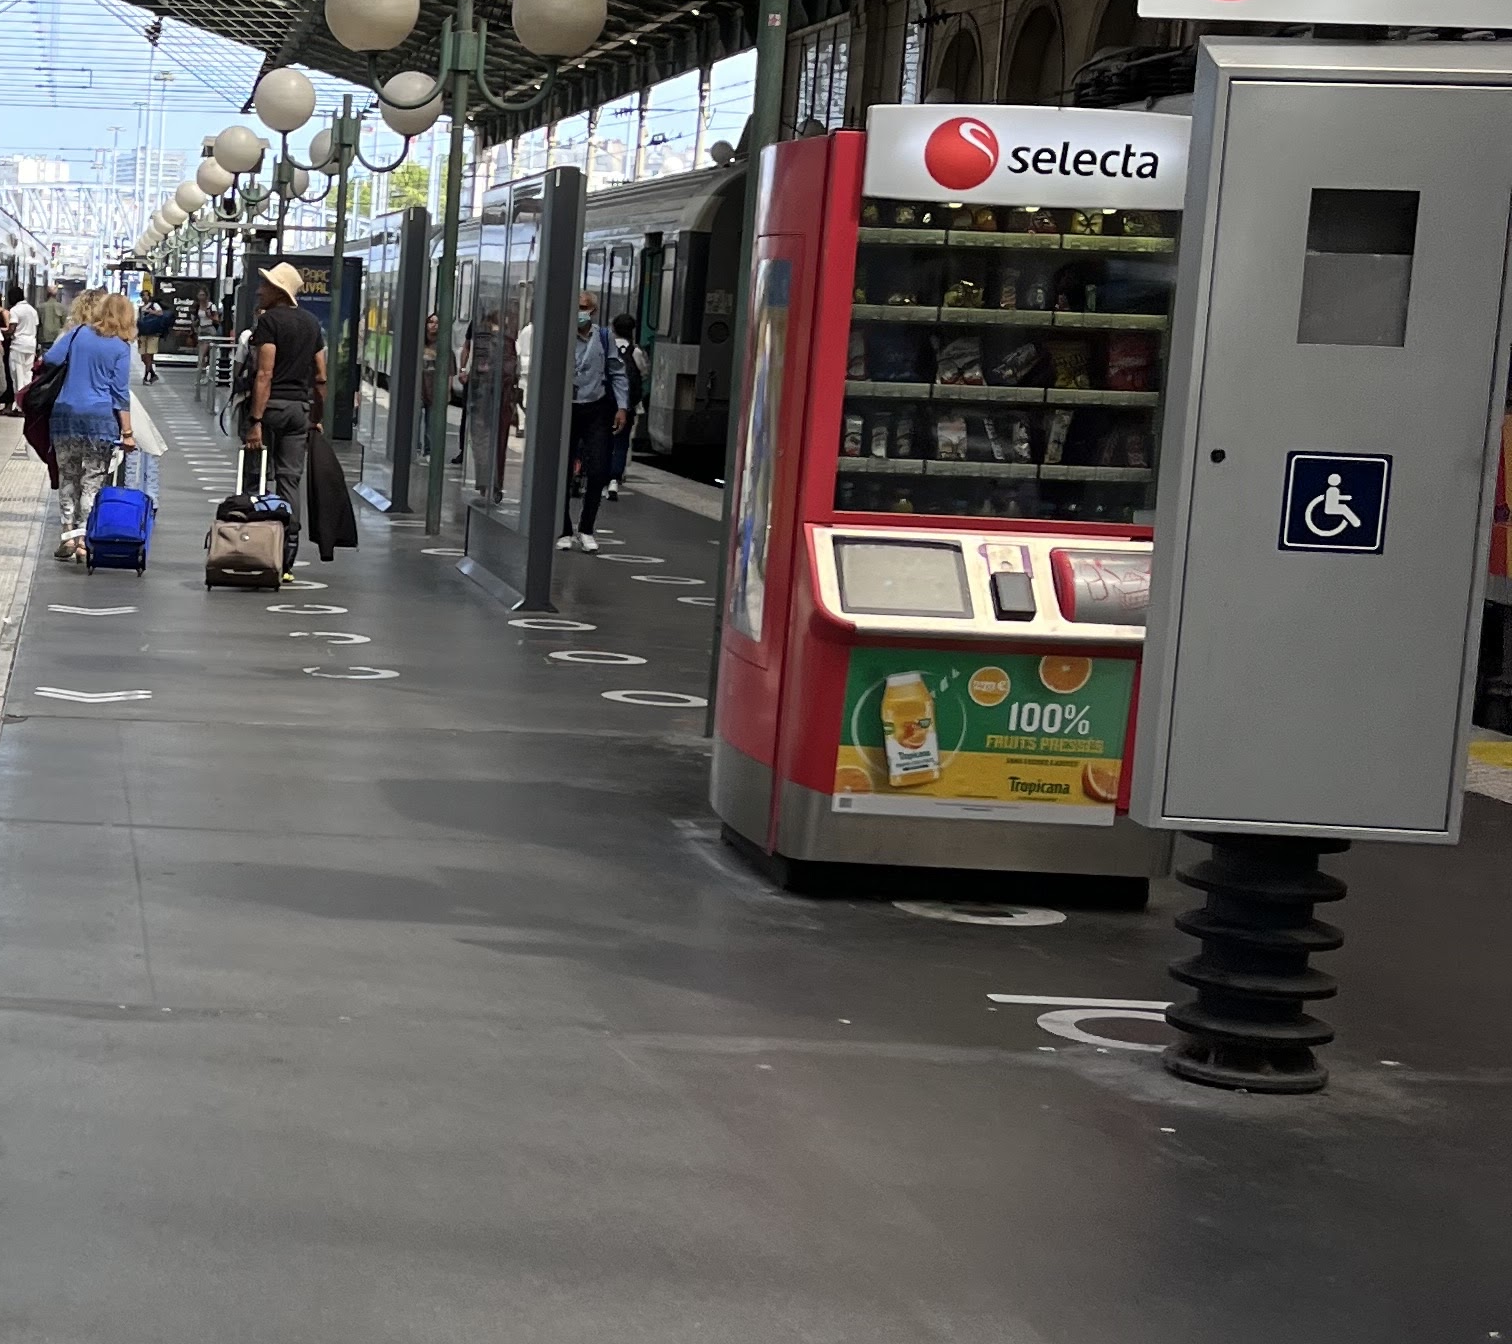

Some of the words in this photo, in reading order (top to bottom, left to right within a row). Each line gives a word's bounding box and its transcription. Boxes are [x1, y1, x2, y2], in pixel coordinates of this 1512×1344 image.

[1007, 141, 1160, 179] selecta
[1008, 701, 1091, 735] 100%
[1008, 776, 1071, 796] Tropicana
